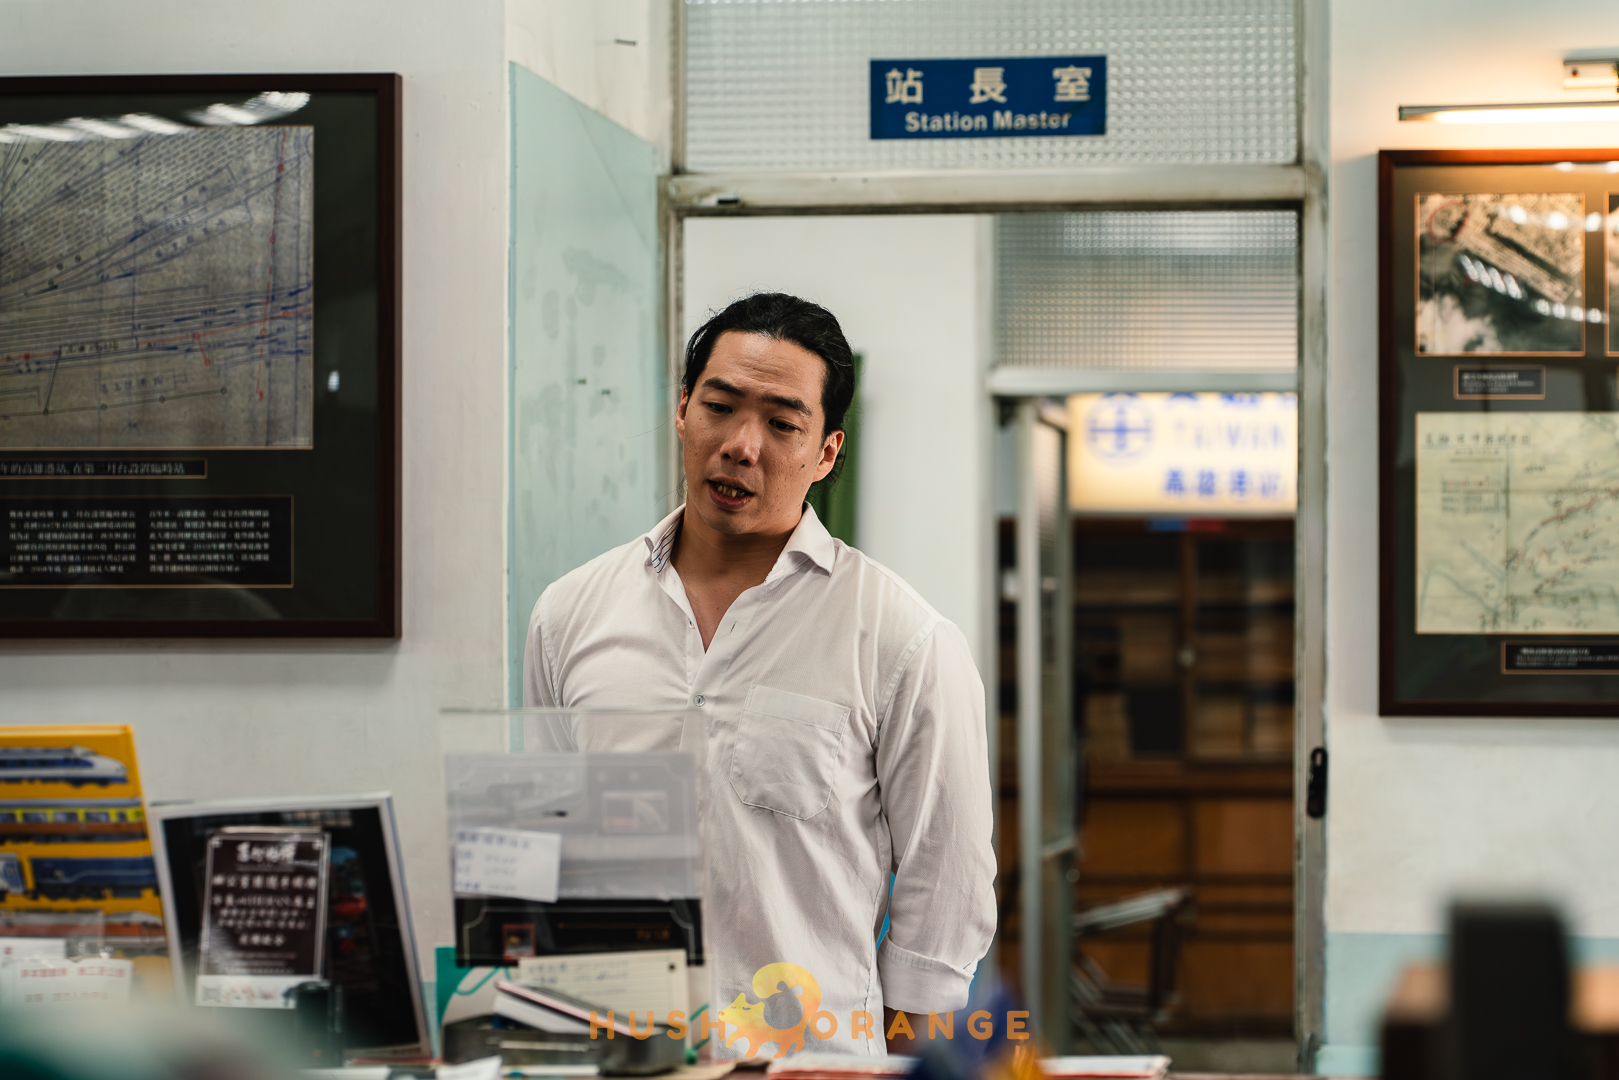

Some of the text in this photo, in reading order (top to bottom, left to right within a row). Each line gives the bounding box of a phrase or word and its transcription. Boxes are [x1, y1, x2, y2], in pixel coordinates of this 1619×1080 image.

[884, 65, 1092, 104] 站長室
[904, 110, 1072, 133] Station Master
